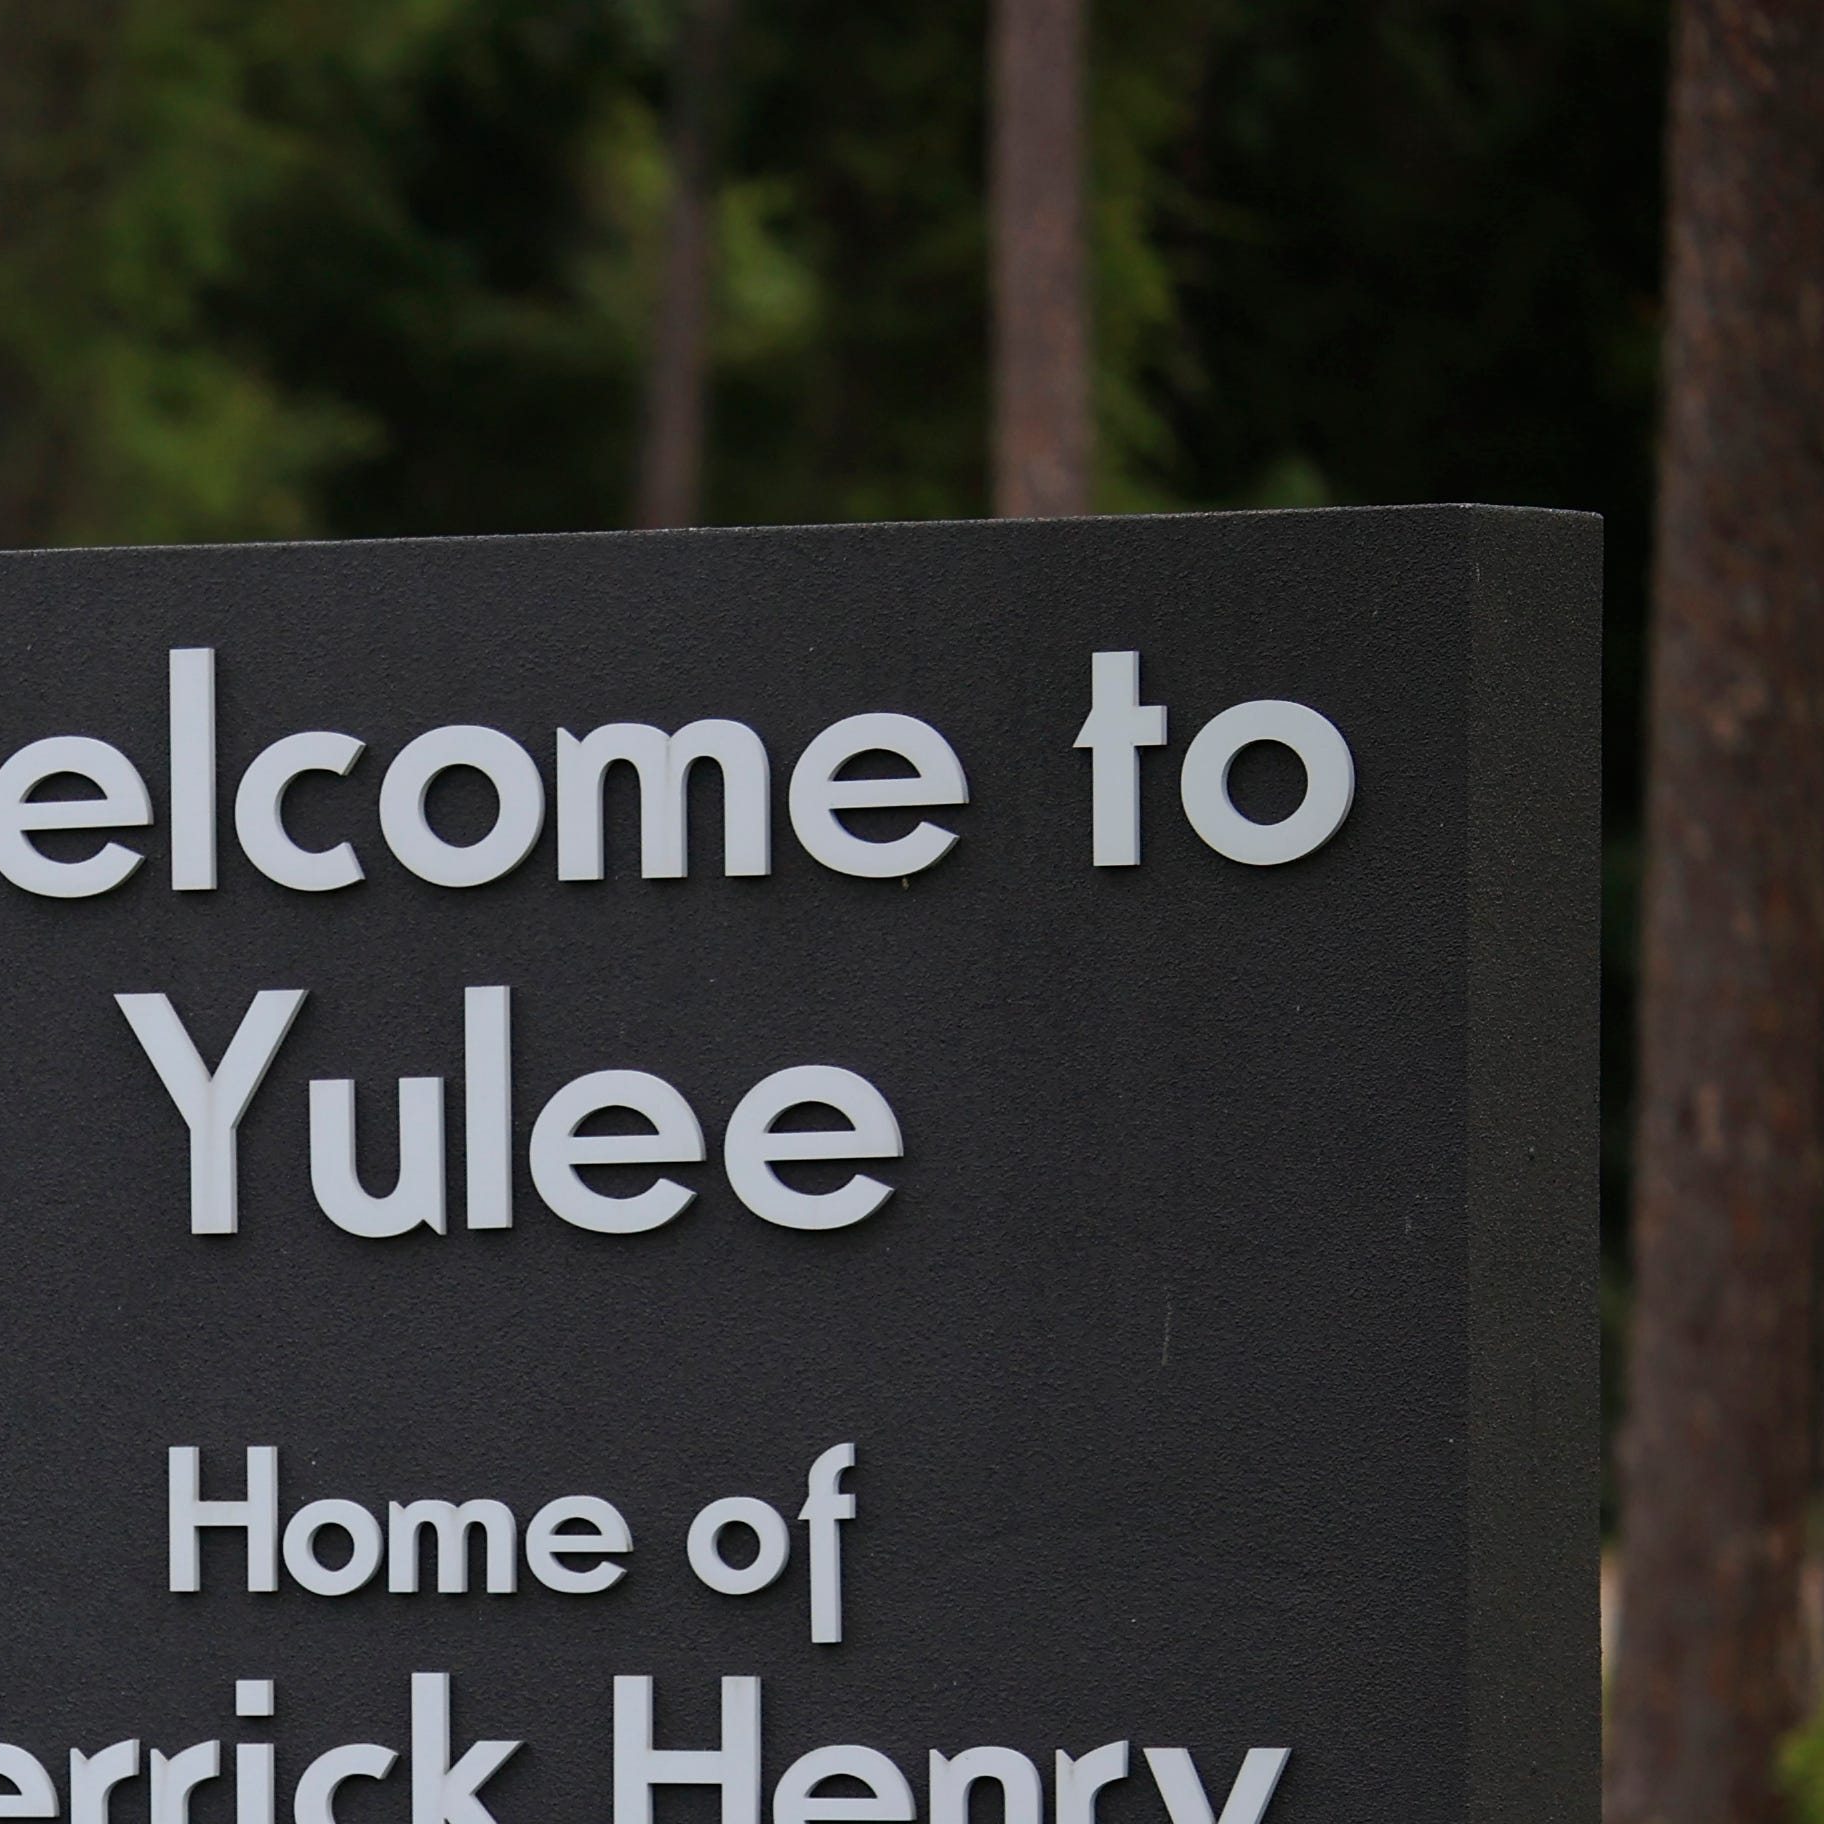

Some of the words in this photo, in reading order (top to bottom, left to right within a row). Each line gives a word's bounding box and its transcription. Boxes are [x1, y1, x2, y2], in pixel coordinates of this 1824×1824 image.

[1072, 650, 1354, 867] to
[113, 985, 904, 1238] Yulee
[168, 1445, 633, 1597] Home
[686, 1442, 856, 1643] of
